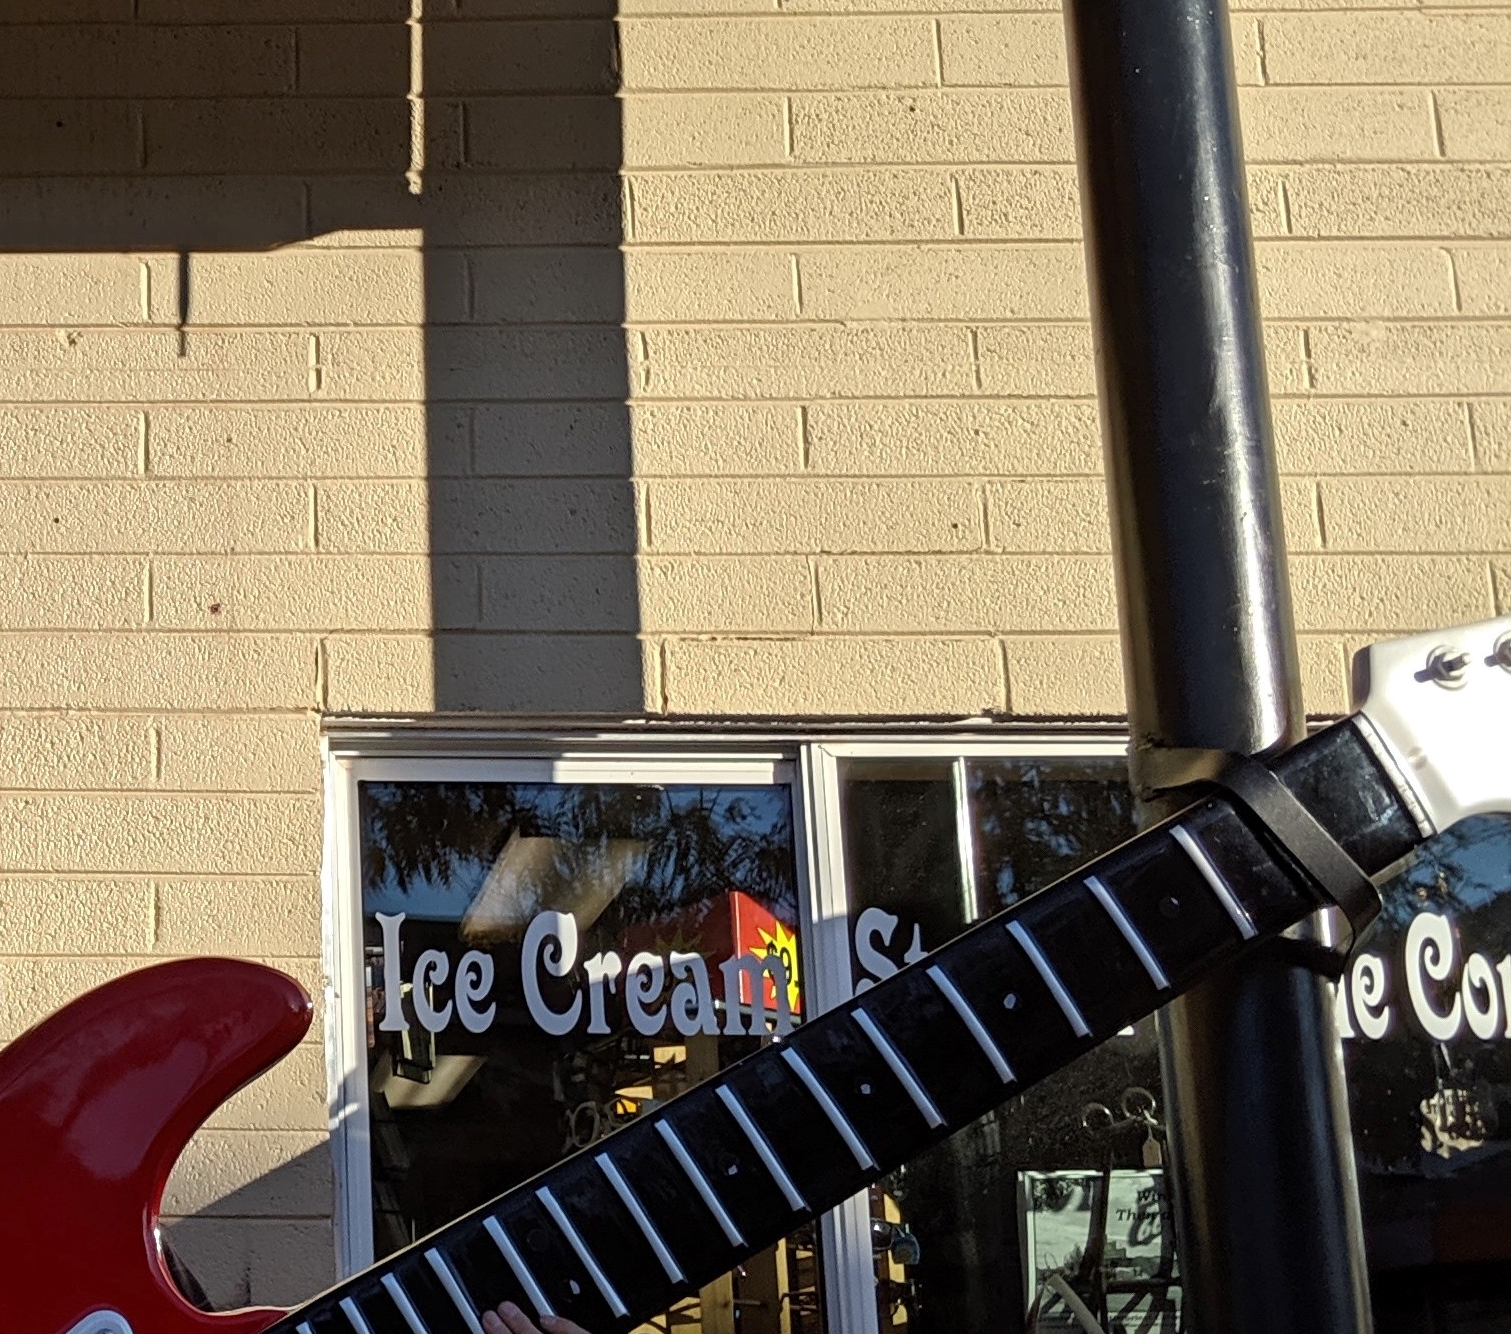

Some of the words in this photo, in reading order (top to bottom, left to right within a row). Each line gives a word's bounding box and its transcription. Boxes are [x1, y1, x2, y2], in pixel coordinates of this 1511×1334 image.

[374, 911, 497, 1034] Ice
[521, 911, 795, 1037] Cream
[1405, 911, 1511, 1041] Co
